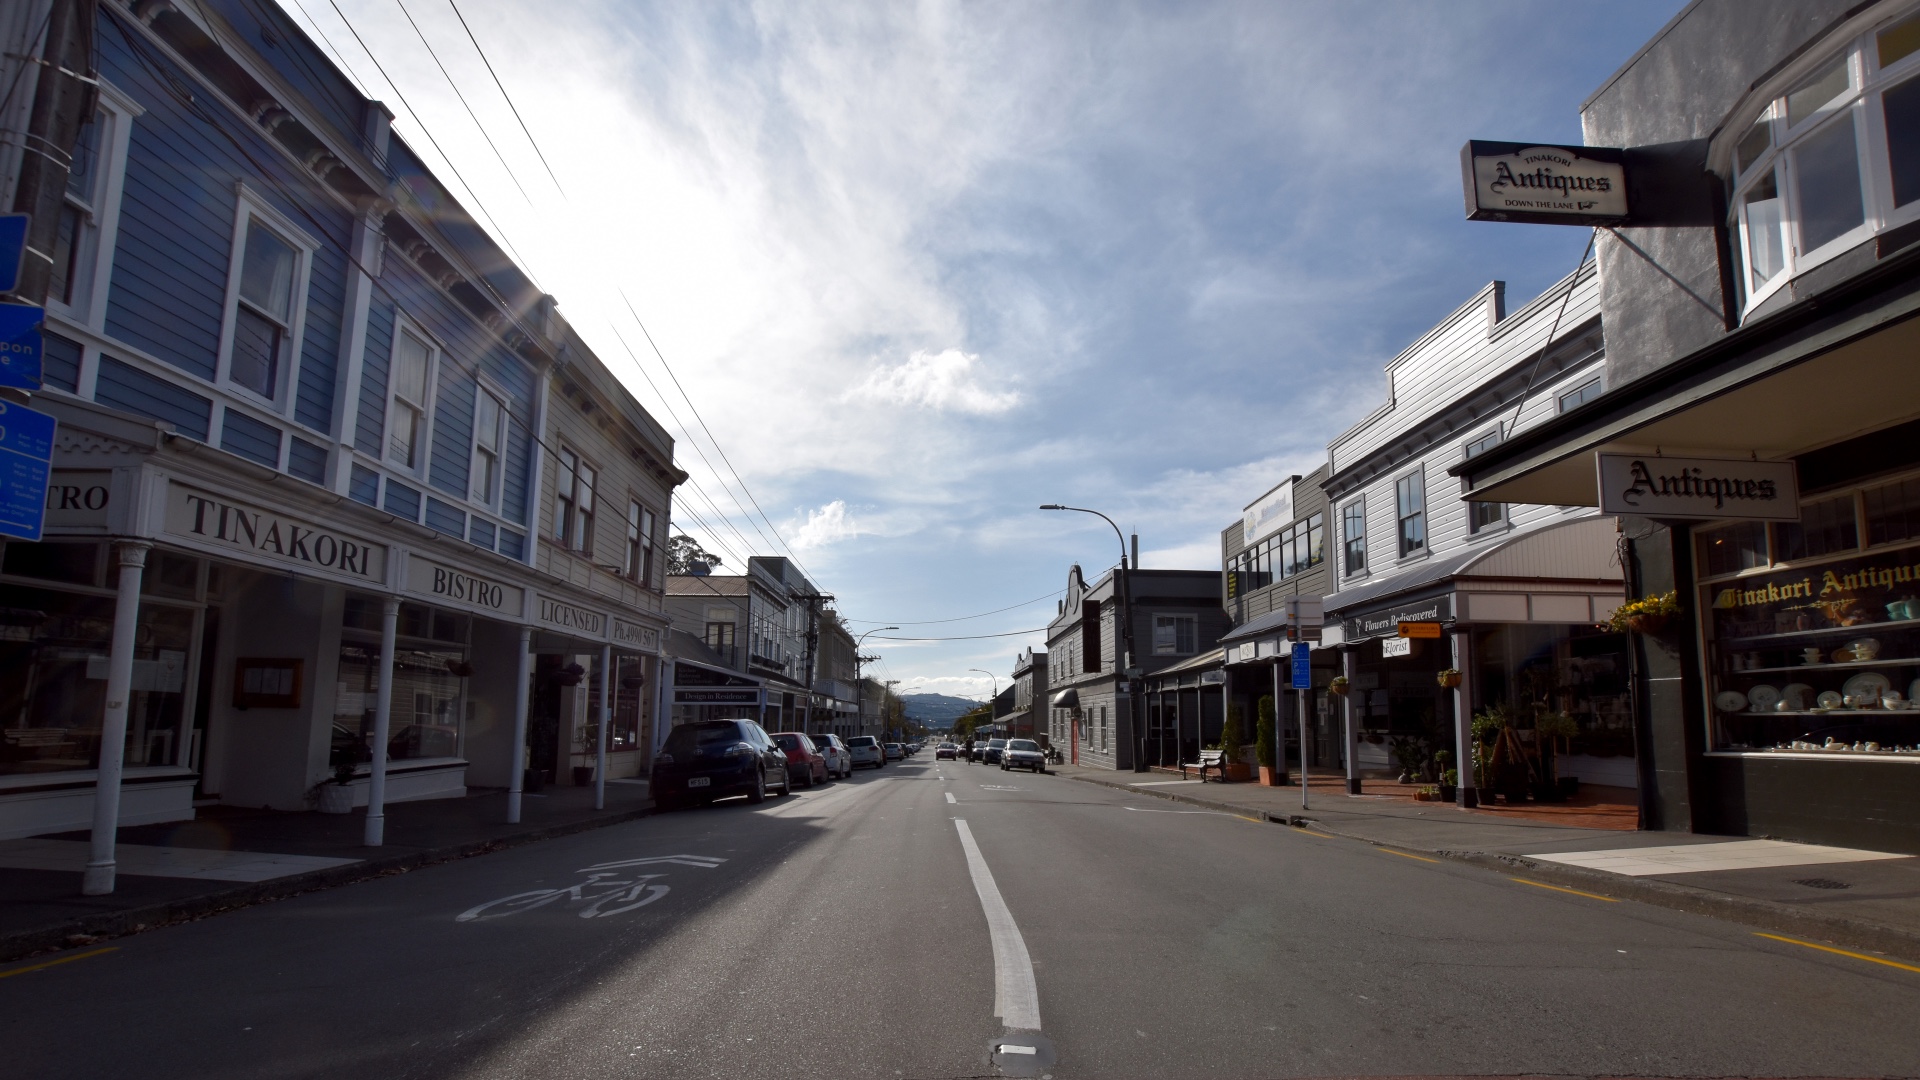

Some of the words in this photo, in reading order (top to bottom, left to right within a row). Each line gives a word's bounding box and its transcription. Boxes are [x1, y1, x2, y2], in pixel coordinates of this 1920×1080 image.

[1524, 154, 1572, 168] TINAKORI
[1490, 161, 1611, 198] Antiques
[1505, 199, 1532, 208] DOWN
[1534, 200, 1552, 208] THE
[1553, 201, 1574, 209] LANE
[1622, 460, 1777, 509] Antiques
[186, 494, 371, 577] TINAKORI
[433, 563, 503, 608] BISTRO
[1719, 577, 1811, 608] Tinakori
[540, 600, 599, 633] LICENSED
[1364, 616, 1389, 632] Flowers
[1390, 605, 1438, 626] Rediscovered
[1384, 640, 1408, 654] Florist
[685, 692, 707, 701] Design
[707, 692, 714, 700] in
[715, 692, 747, 700] Residence
